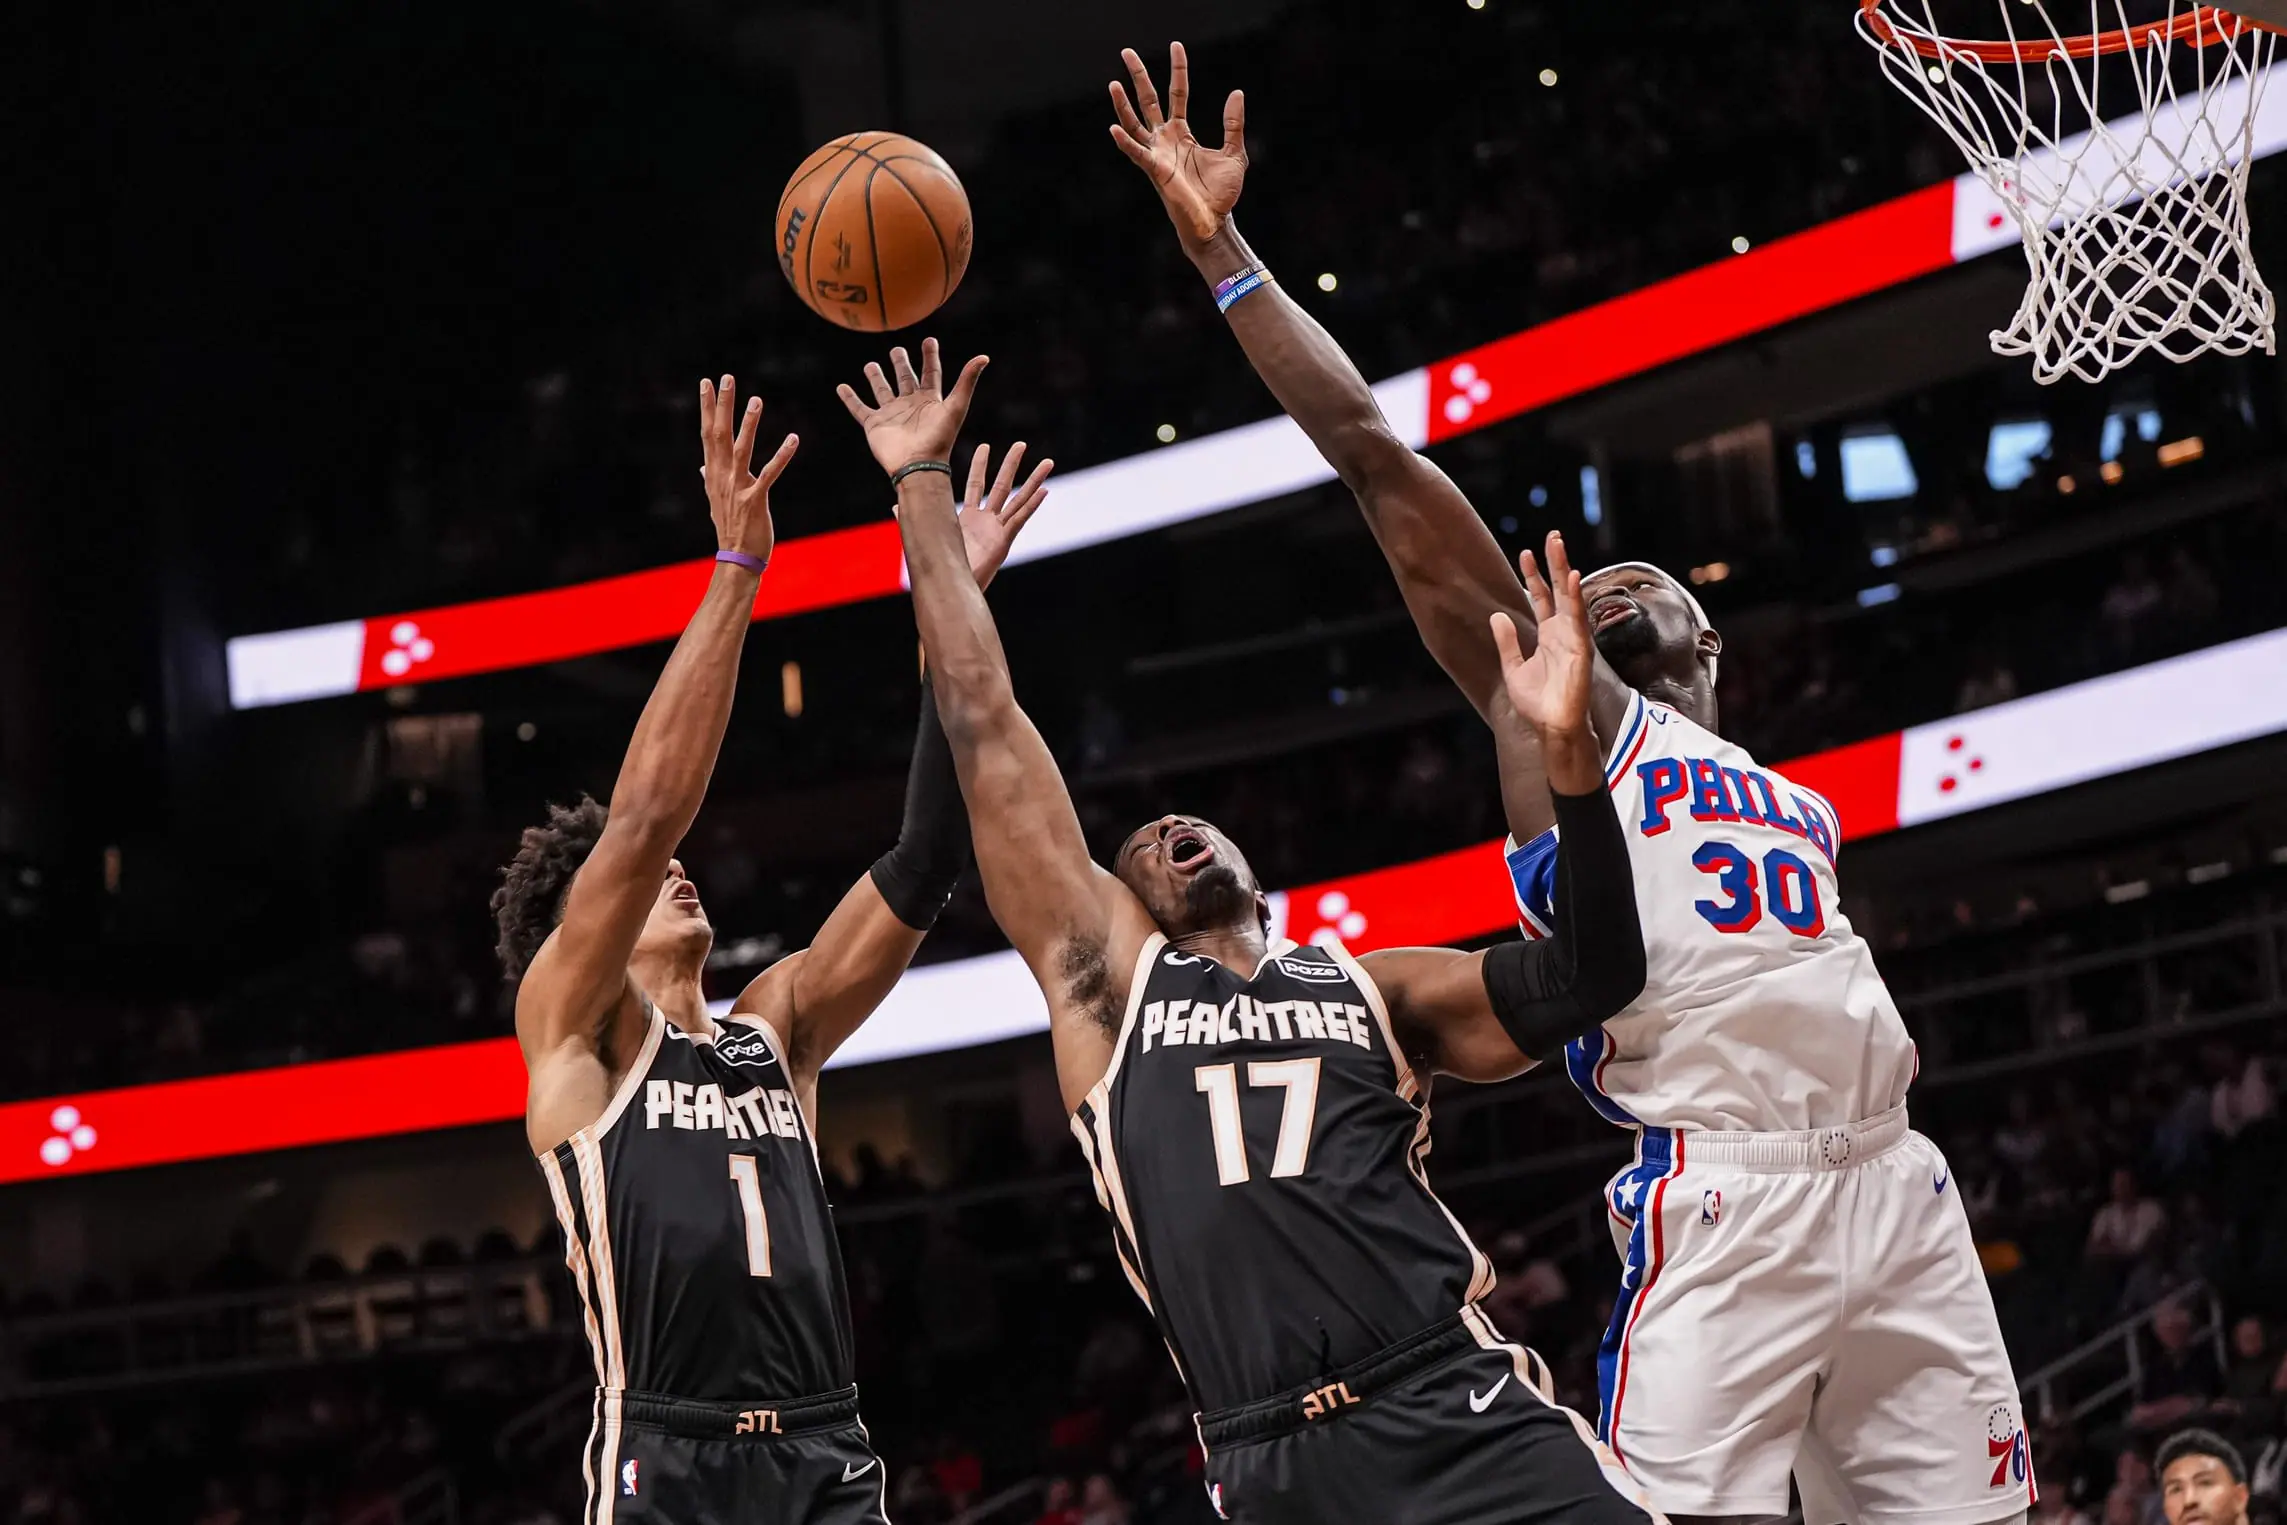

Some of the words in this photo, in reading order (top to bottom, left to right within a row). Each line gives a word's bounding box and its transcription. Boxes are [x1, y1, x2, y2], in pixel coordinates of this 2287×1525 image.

[1692, 841, 1826, 939] 30
[1284, 962, 1338, 976] paze
[1142, 992, 1371, 1054] PEACHTREE
[1194, 1057, 1322, 1186] 17
[728, 1154, 773, 1277] 1
[735, 1410, 783, 1435] ATL
[1302, 1382, 1361, 1420] ATL
[1988, 1429, 2026, 1488] 76
